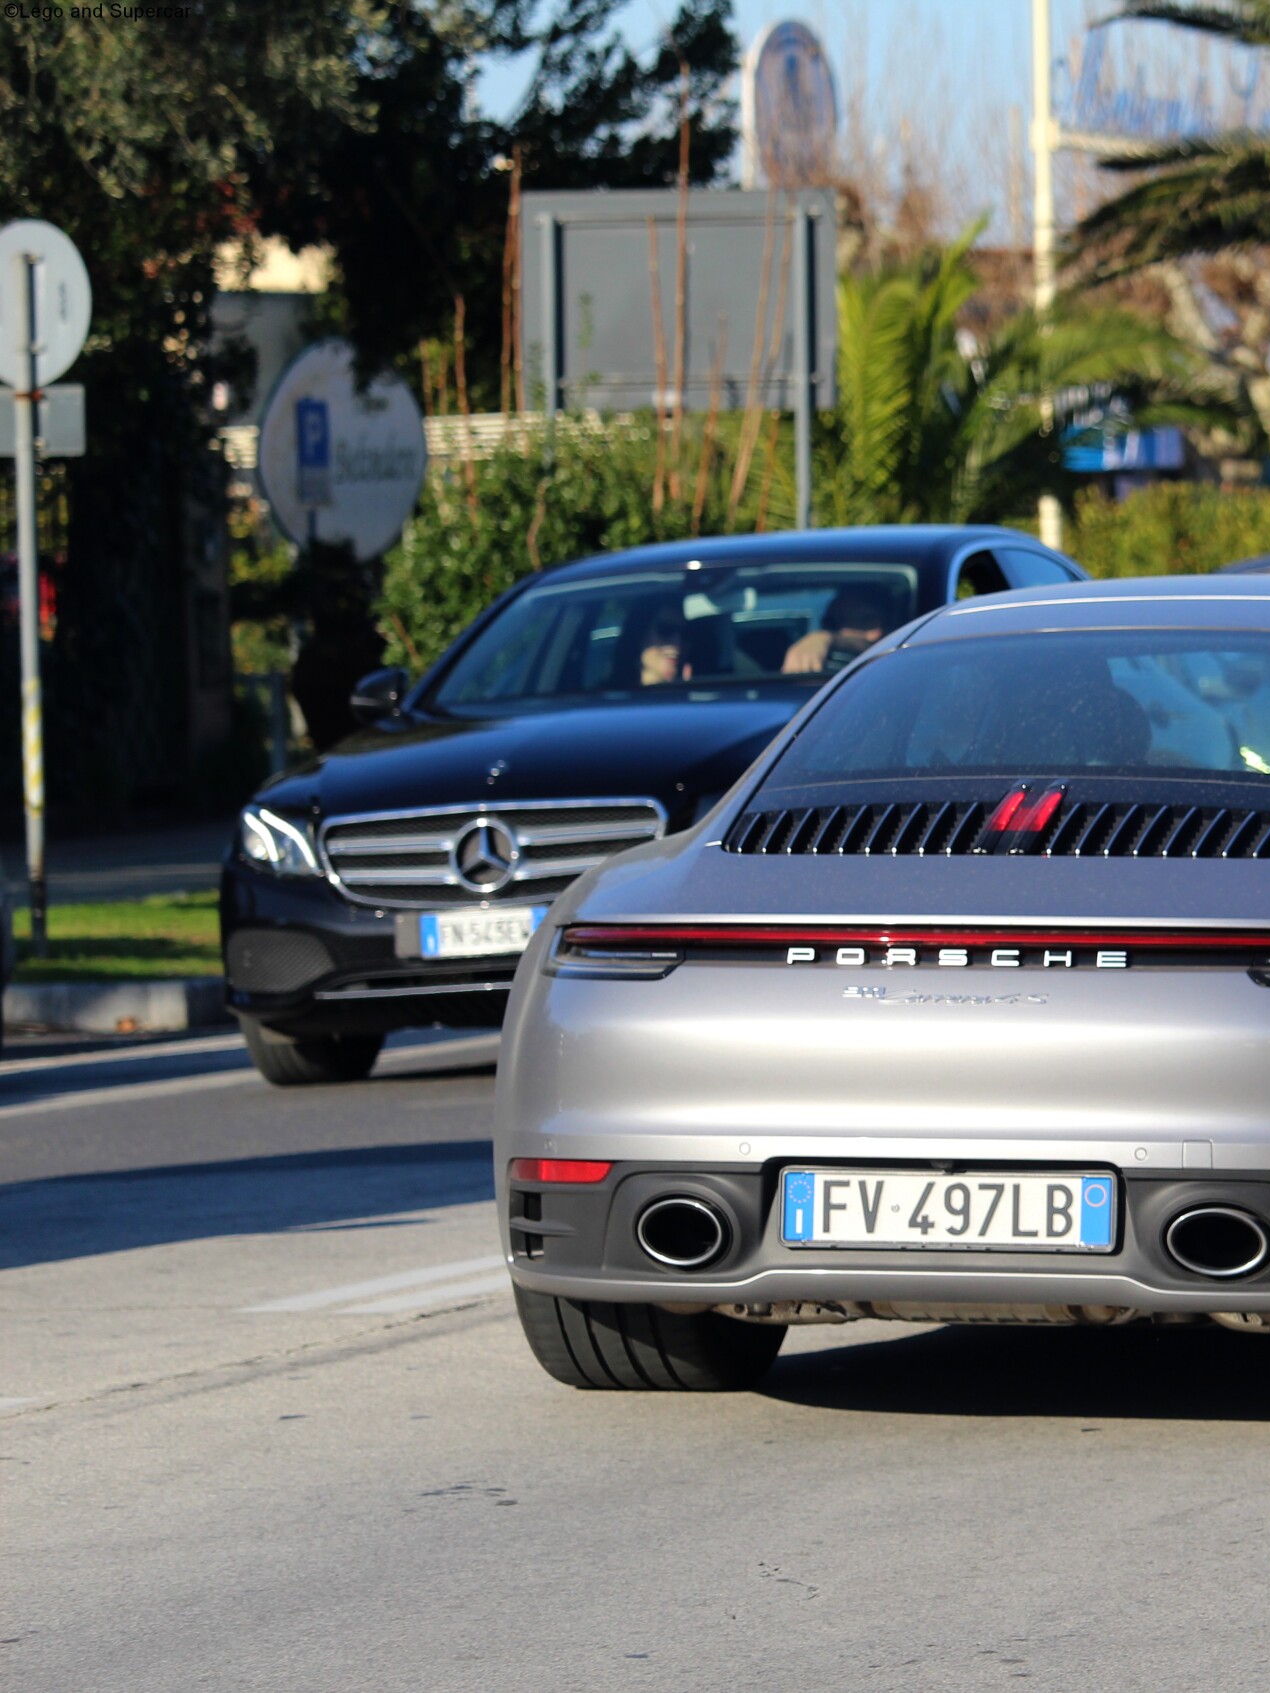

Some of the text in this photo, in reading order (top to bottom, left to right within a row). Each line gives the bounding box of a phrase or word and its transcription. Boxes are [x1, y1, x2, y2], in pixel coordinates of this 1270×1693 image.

[787, 947, 1128, 968] PORSCHE
[822, 1179, 1074, 1237] FV 497LB
